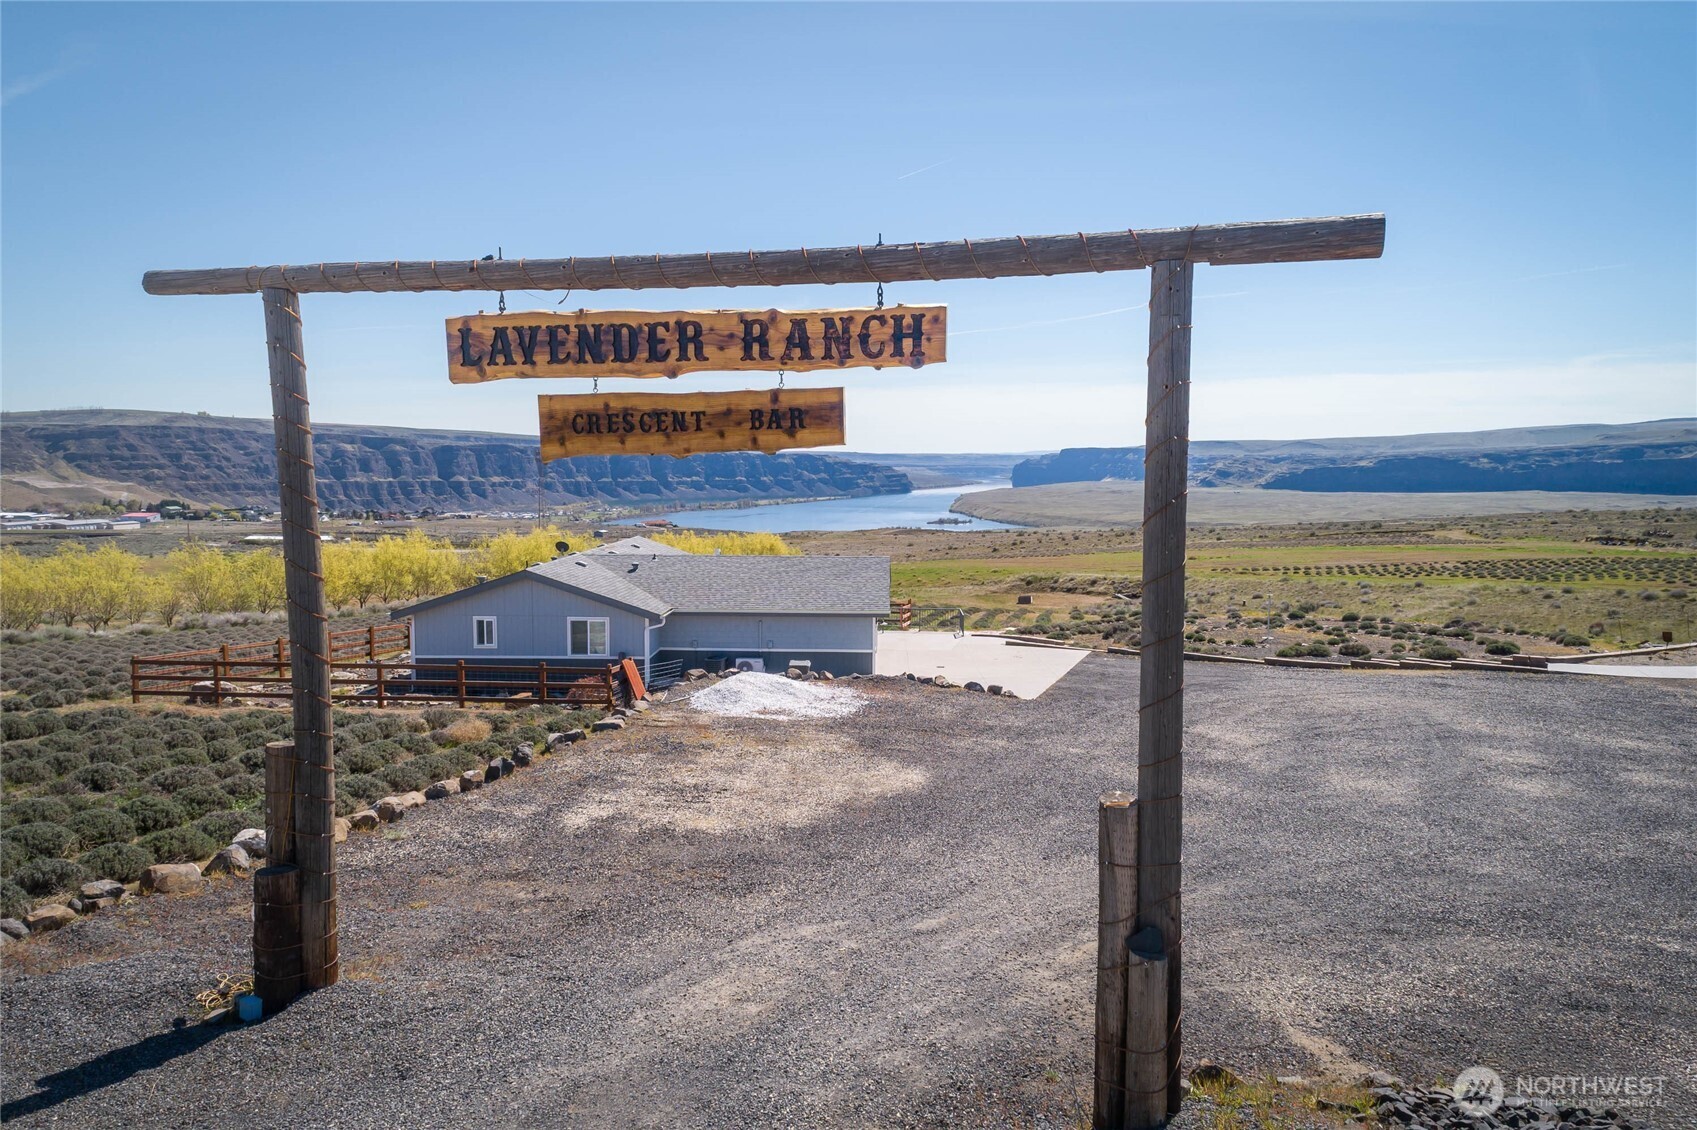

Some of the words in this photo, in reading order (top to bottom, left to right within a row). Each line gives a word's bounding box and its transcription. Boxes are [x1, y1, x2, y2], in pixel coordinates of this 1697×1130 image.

[457, 319, 709, 368] LAVENDER
[741, 313, 926, 362] RANCH
[571, 410, 707, 435] CRESCENT
[749, 407, 807, 430] BAR
